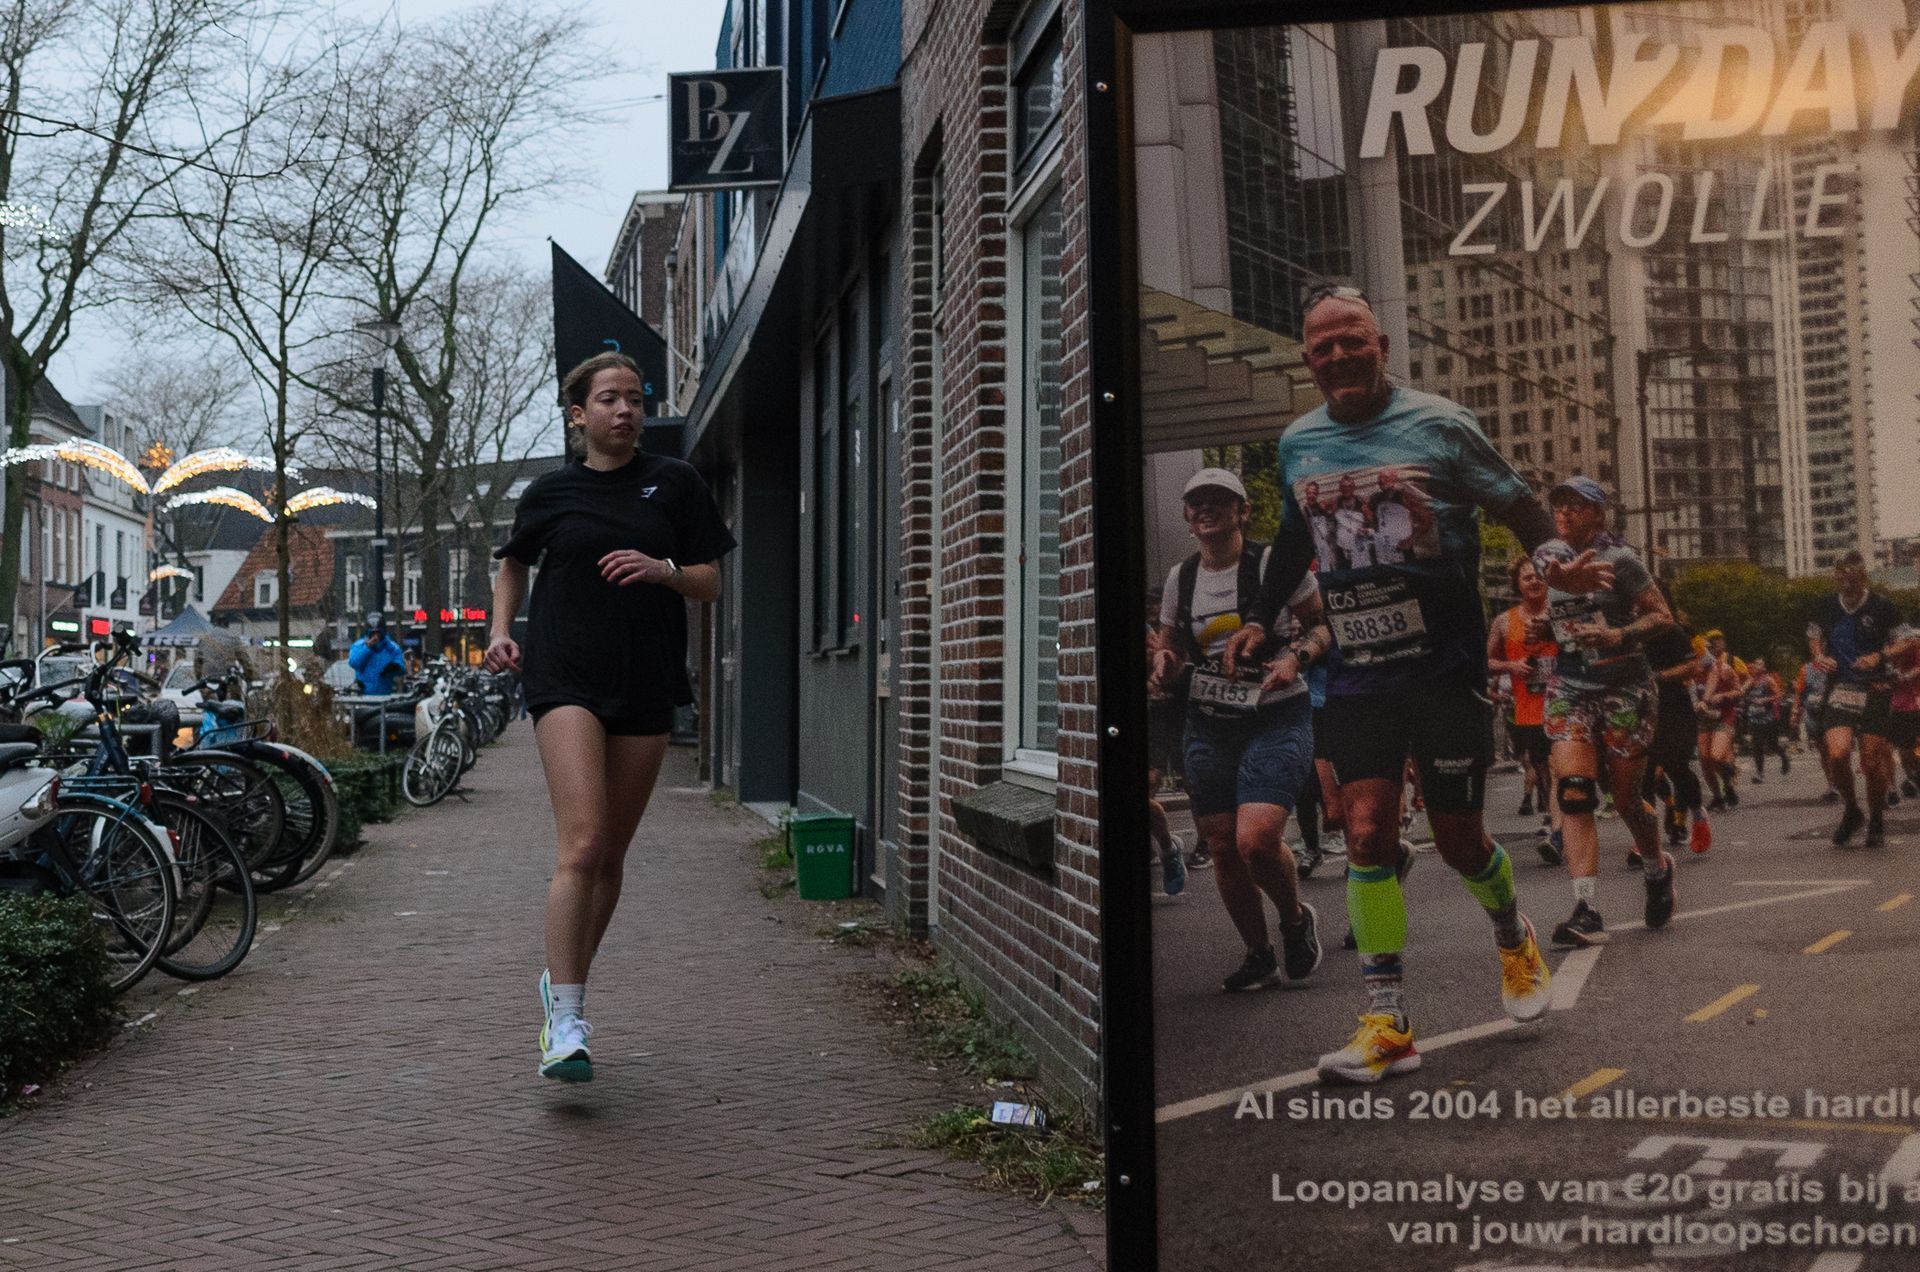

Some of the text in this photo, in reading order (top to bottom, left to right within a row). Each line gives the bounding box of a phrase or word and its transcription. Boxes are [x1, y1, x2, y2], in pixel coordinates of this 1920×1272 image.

[1359, 23, 1920, 158] RUN2DAY
[1449, 162, 1858, 256] ZWOLLE
[1343, 610, 1408, 641] 58838
[1200, 680, 1249, 703] 74153
[806, 844, 845, 854] ROVA
[1234, 1091, 1274, 1120] Al
[1287, 1091, 1395, 1120] sinds
[1408, 1090, 1502, 1120] 2004
[1514, 1089, 1577, 1119] het
[1590, 1088, 1790, 1119] allerbeste
[1272, 1174, 1525, 1210] Loopanalyse
[1538, 1180, 1610, 1202] van
[1623, 1173, 1694, 1203] €20
[1708, 1172, 1824, 1211] gratis
[1839, 1172, 1889, 1211] bij
[1387, 1215, 1917, 1251] van jouw hardloopschoen
